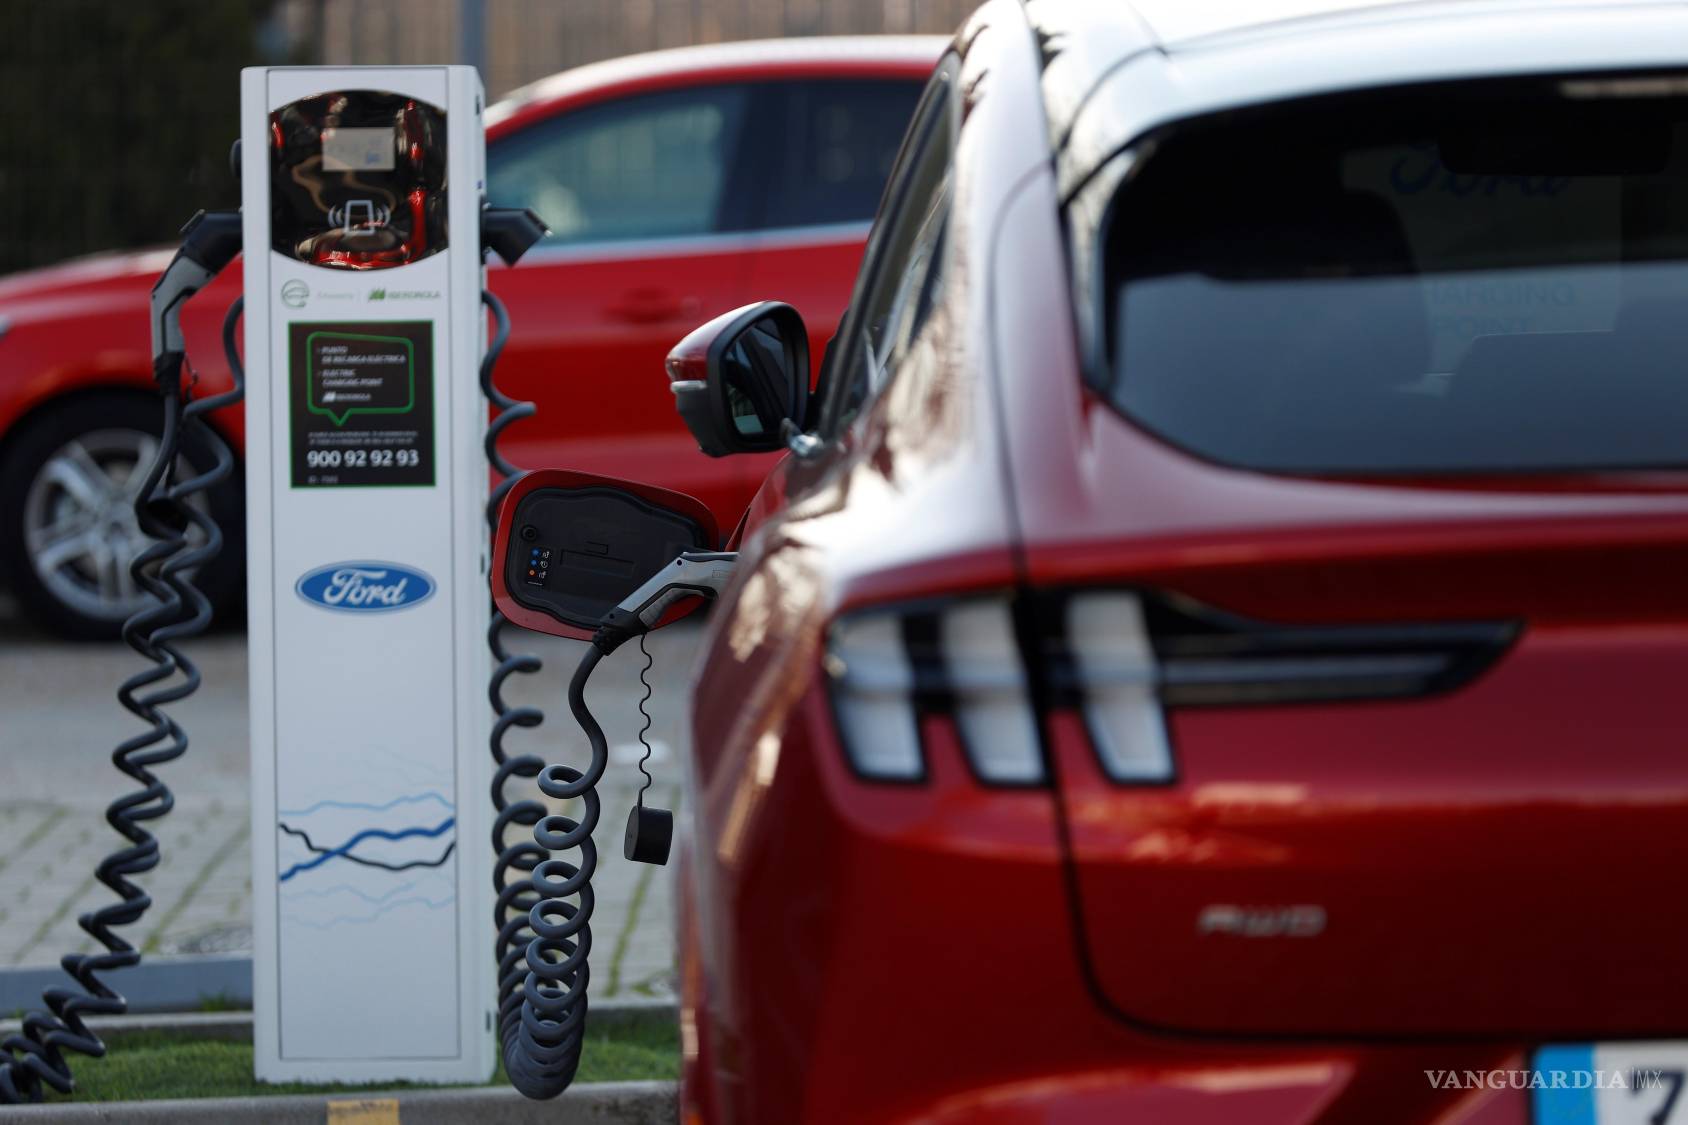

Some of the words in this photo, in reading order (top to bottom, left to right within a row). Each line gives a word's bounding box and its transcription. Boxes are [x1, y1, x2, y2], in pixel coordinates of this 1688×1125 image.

[307, 450, 341, 467] 900
[344, 450, 367, 467] 92
[370, 449, 393, 467] 92
[396, 449, 419, 467] 93
[322, 568, 408, 605] Ford
